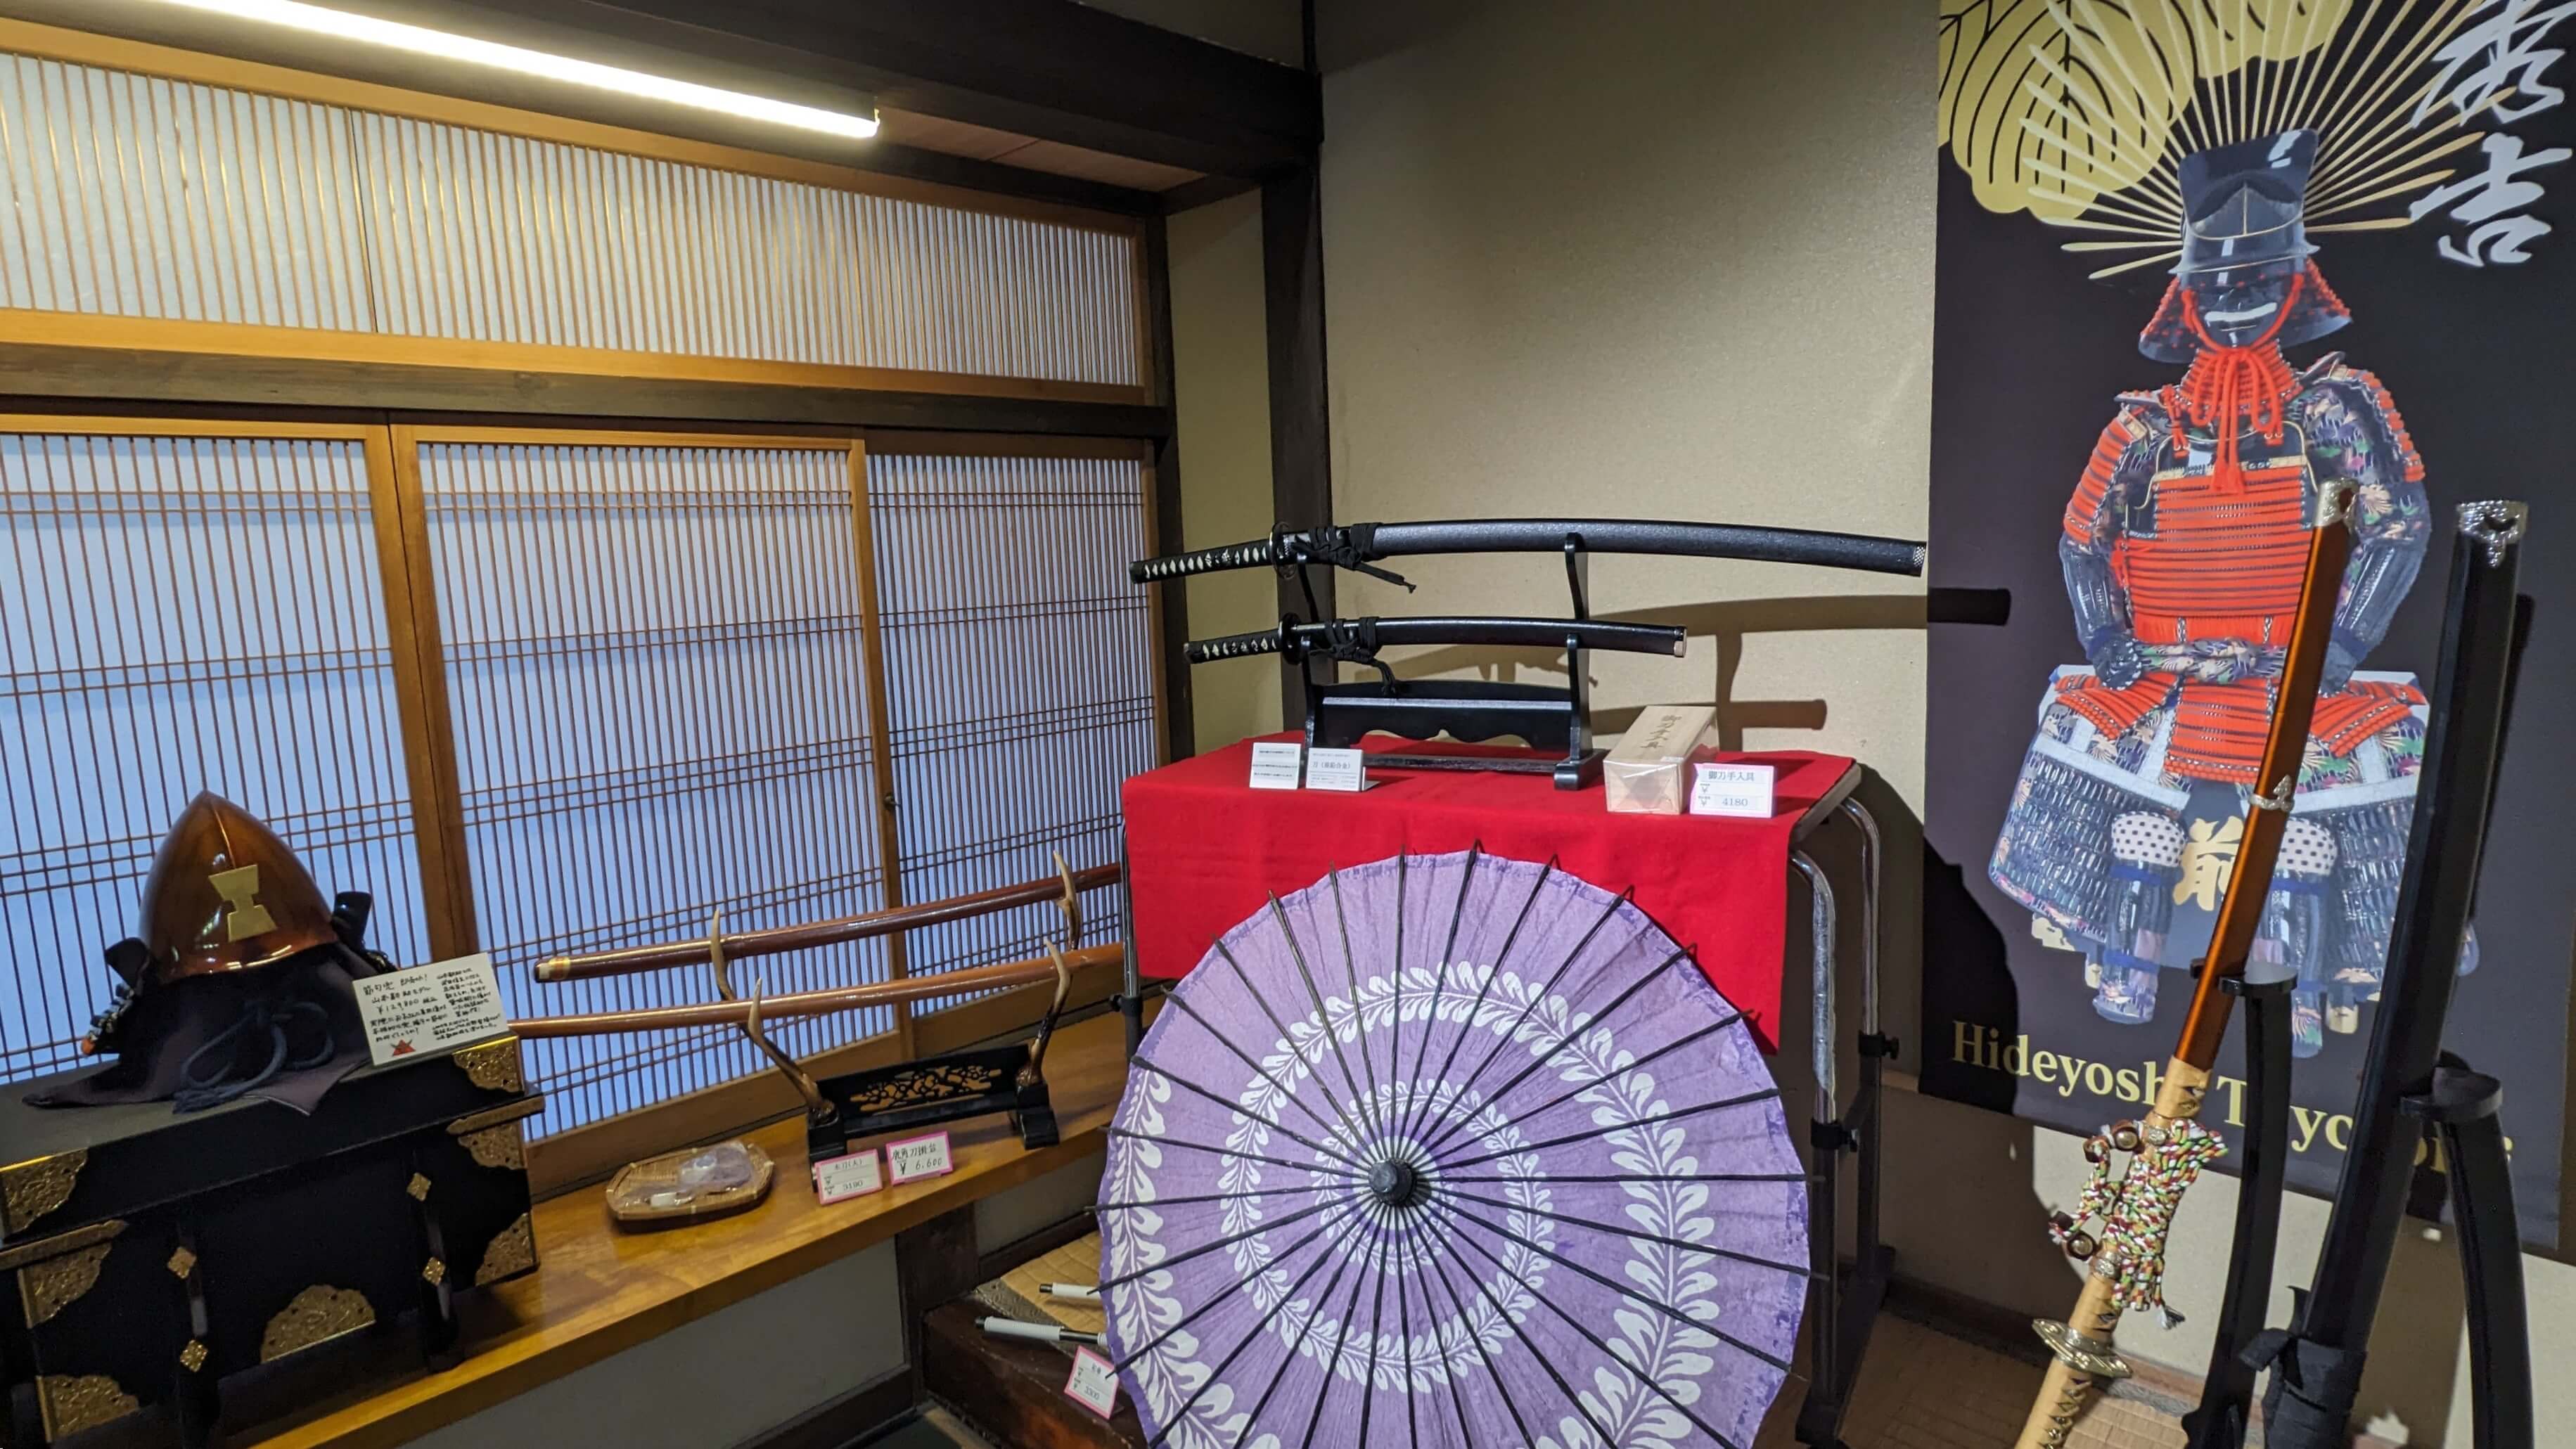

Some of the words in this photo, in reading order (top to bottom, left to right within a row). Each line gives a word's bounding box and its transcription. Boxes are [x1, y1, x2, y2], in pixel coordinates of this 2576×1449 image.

[1708, 770, 1755, 781] 御刀手入具
[1722, 798, 1748, 806] 4180
[1952, 1020, 2168, 1106] Hideyosh
